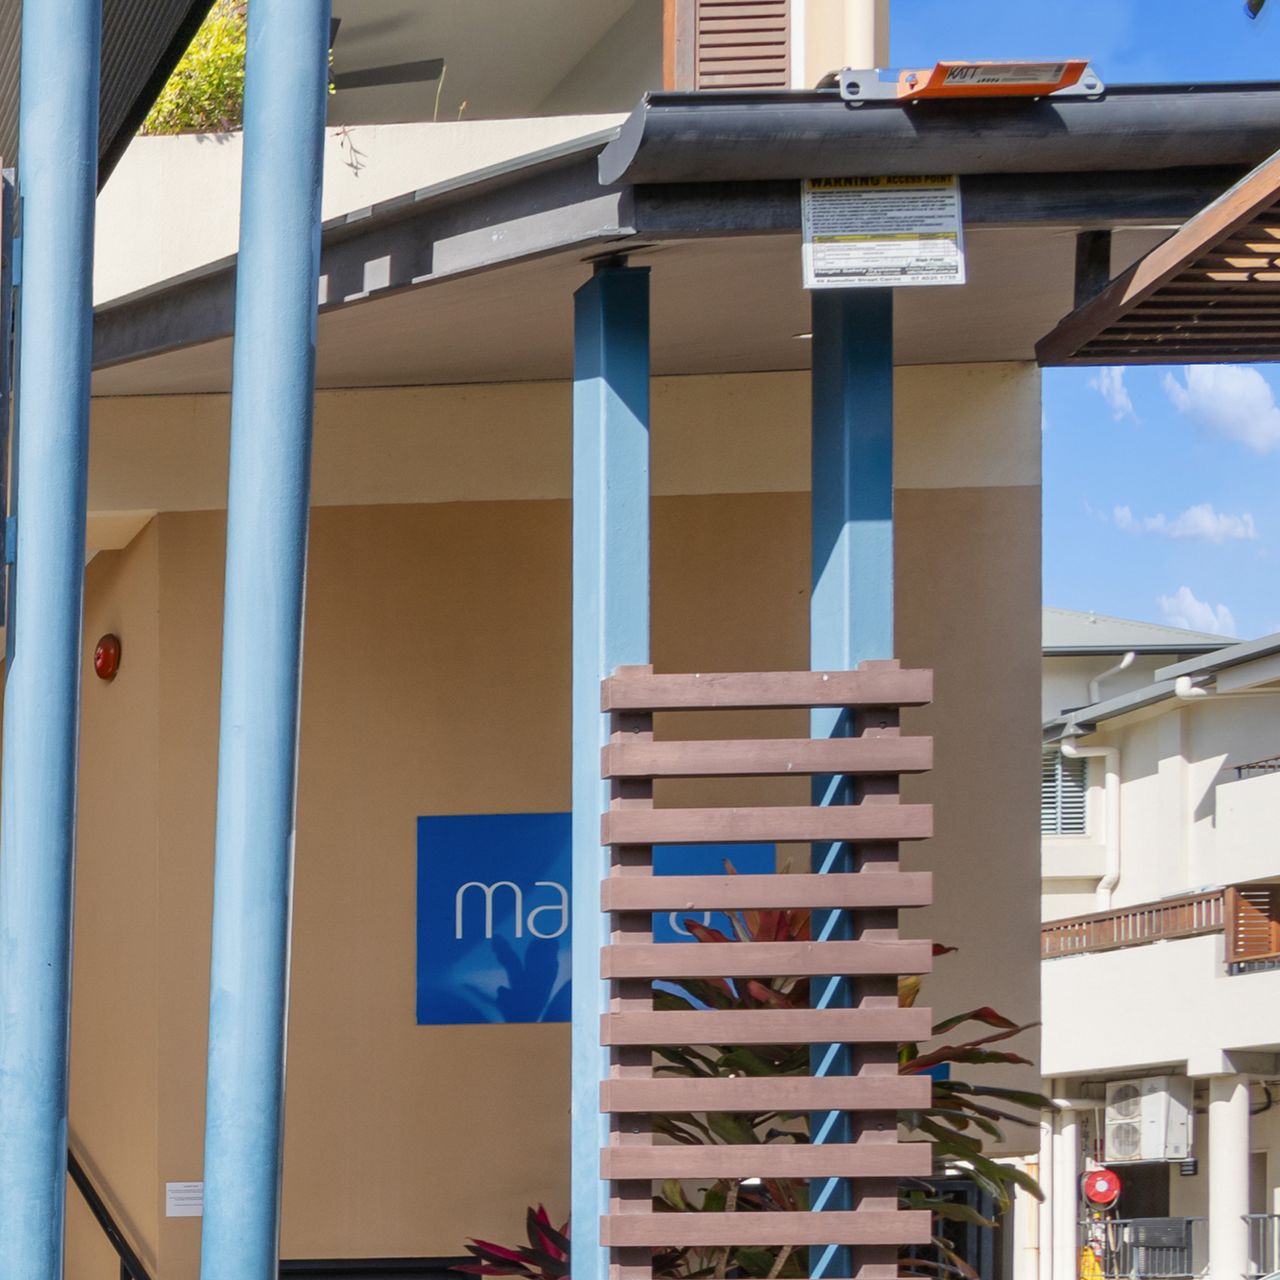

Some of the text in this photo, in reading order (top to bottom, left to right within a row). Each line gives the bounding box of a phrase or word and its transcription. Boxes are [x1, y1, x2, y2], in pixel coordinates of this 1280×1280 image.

[810, 174, 953, 188] WARNING ACCESS POINT
